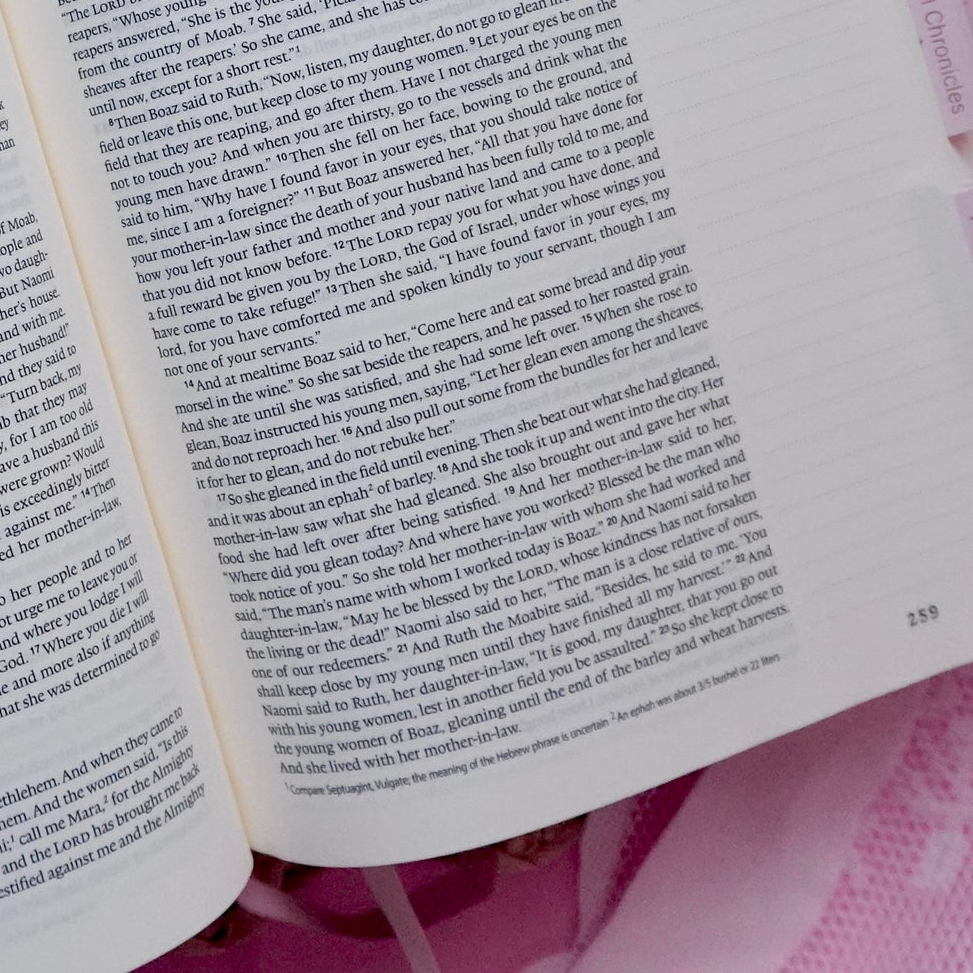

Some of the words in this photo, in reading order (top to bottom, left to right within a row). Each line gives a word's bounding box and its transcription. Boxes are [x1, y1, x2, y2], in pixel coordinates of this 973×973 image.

[924, 10, 965, 115] Chronicles
[163, 365, 184, 377] not
[186, 361, 209, 374] one
[210, 354, 224, 369] of
[226, 350, 257, 368] your
[907, 605, 940, 627] 259
[273, 742, 293, 755] the
[294, 743, 335, 758] young
[337, 736, 388, 752] women
[390, 729, 404, 744] of
[406, 724, 445, 741] Boaz,
[447, 706, 507, 733] gleaning
[508, 692, 541, 713] until
[543, 687, 566, 702] the
[568, 675, 592, 694] end
[595, 668, 608, 685] of
[611, 664, 632, 679] the
[633, 649, 671, 670] barley
[675, 636, 698, 656] and
[699, 624, 737, 645] wheat
[33, 795, 61, 818] And
[62, 788, 85, 805] the
[86, 765, 132, 794] women
[133, 748, 159, 771] said,
[172, 726, 188, 745] this
